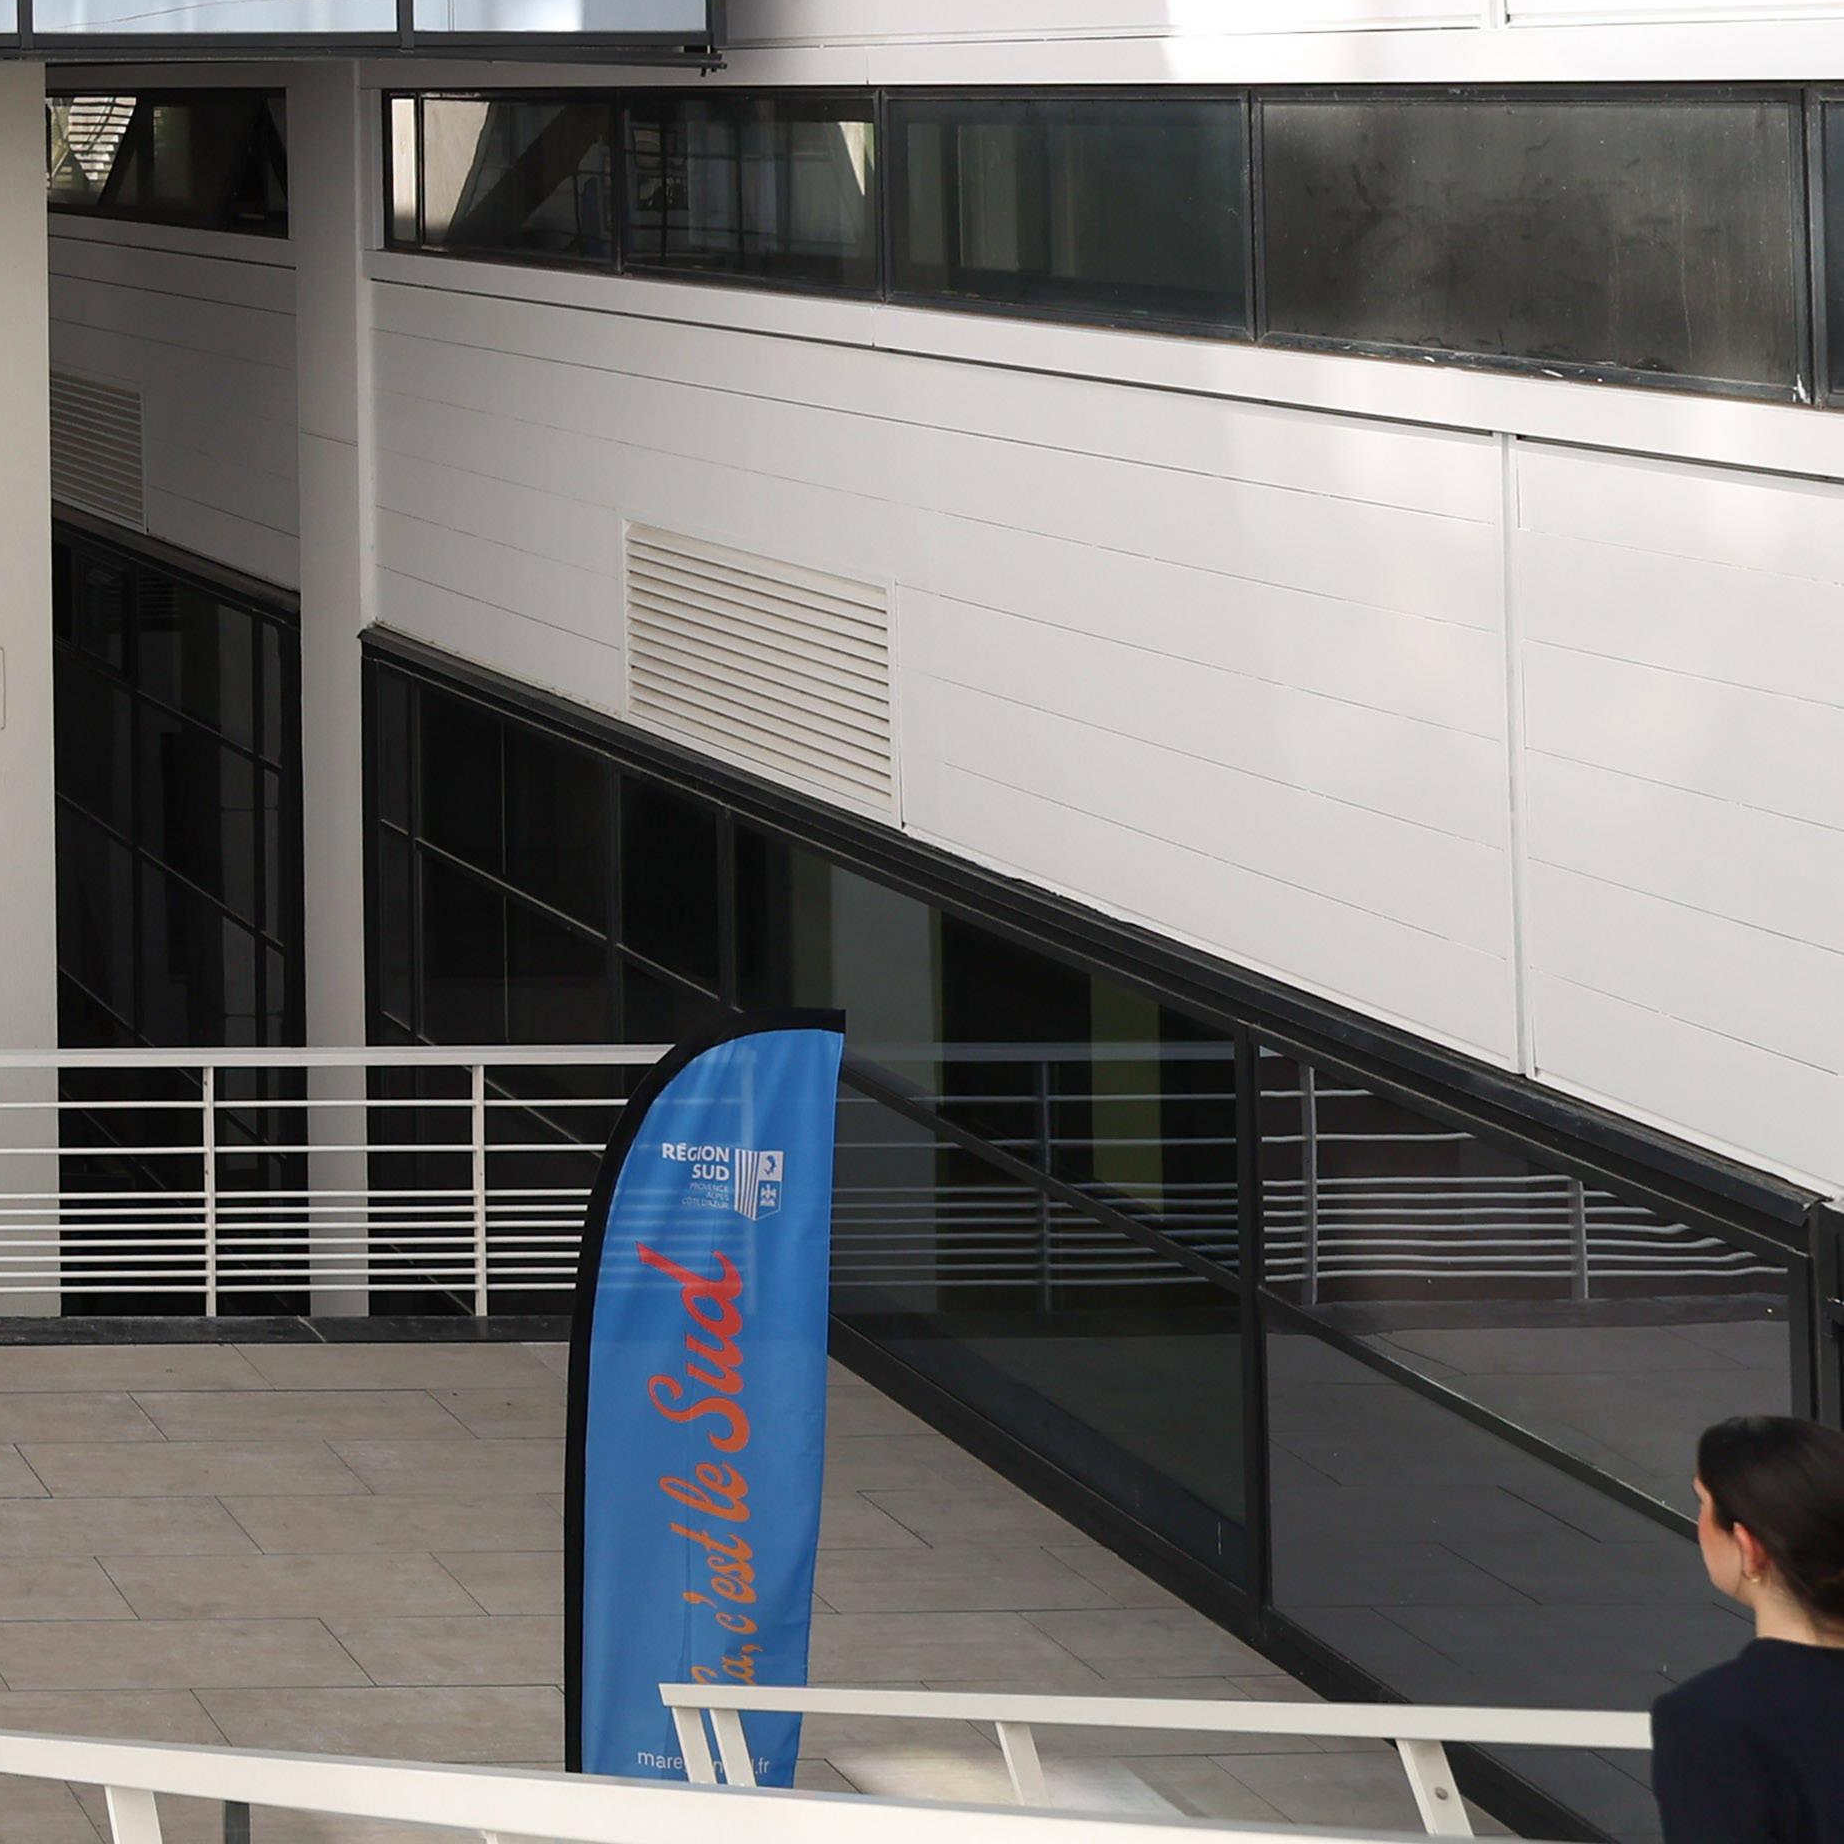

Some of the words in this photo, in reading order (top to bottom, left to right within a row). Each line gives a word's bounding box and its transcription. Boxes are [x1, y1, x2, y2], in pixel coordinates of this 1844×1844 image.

[662, 1142, 730, 1163] RÉGION
[691, 1163, 730, 1181] SUD
[635, 1240, 752, 1453] Sud
[658, 1461, 752, 1523] le
